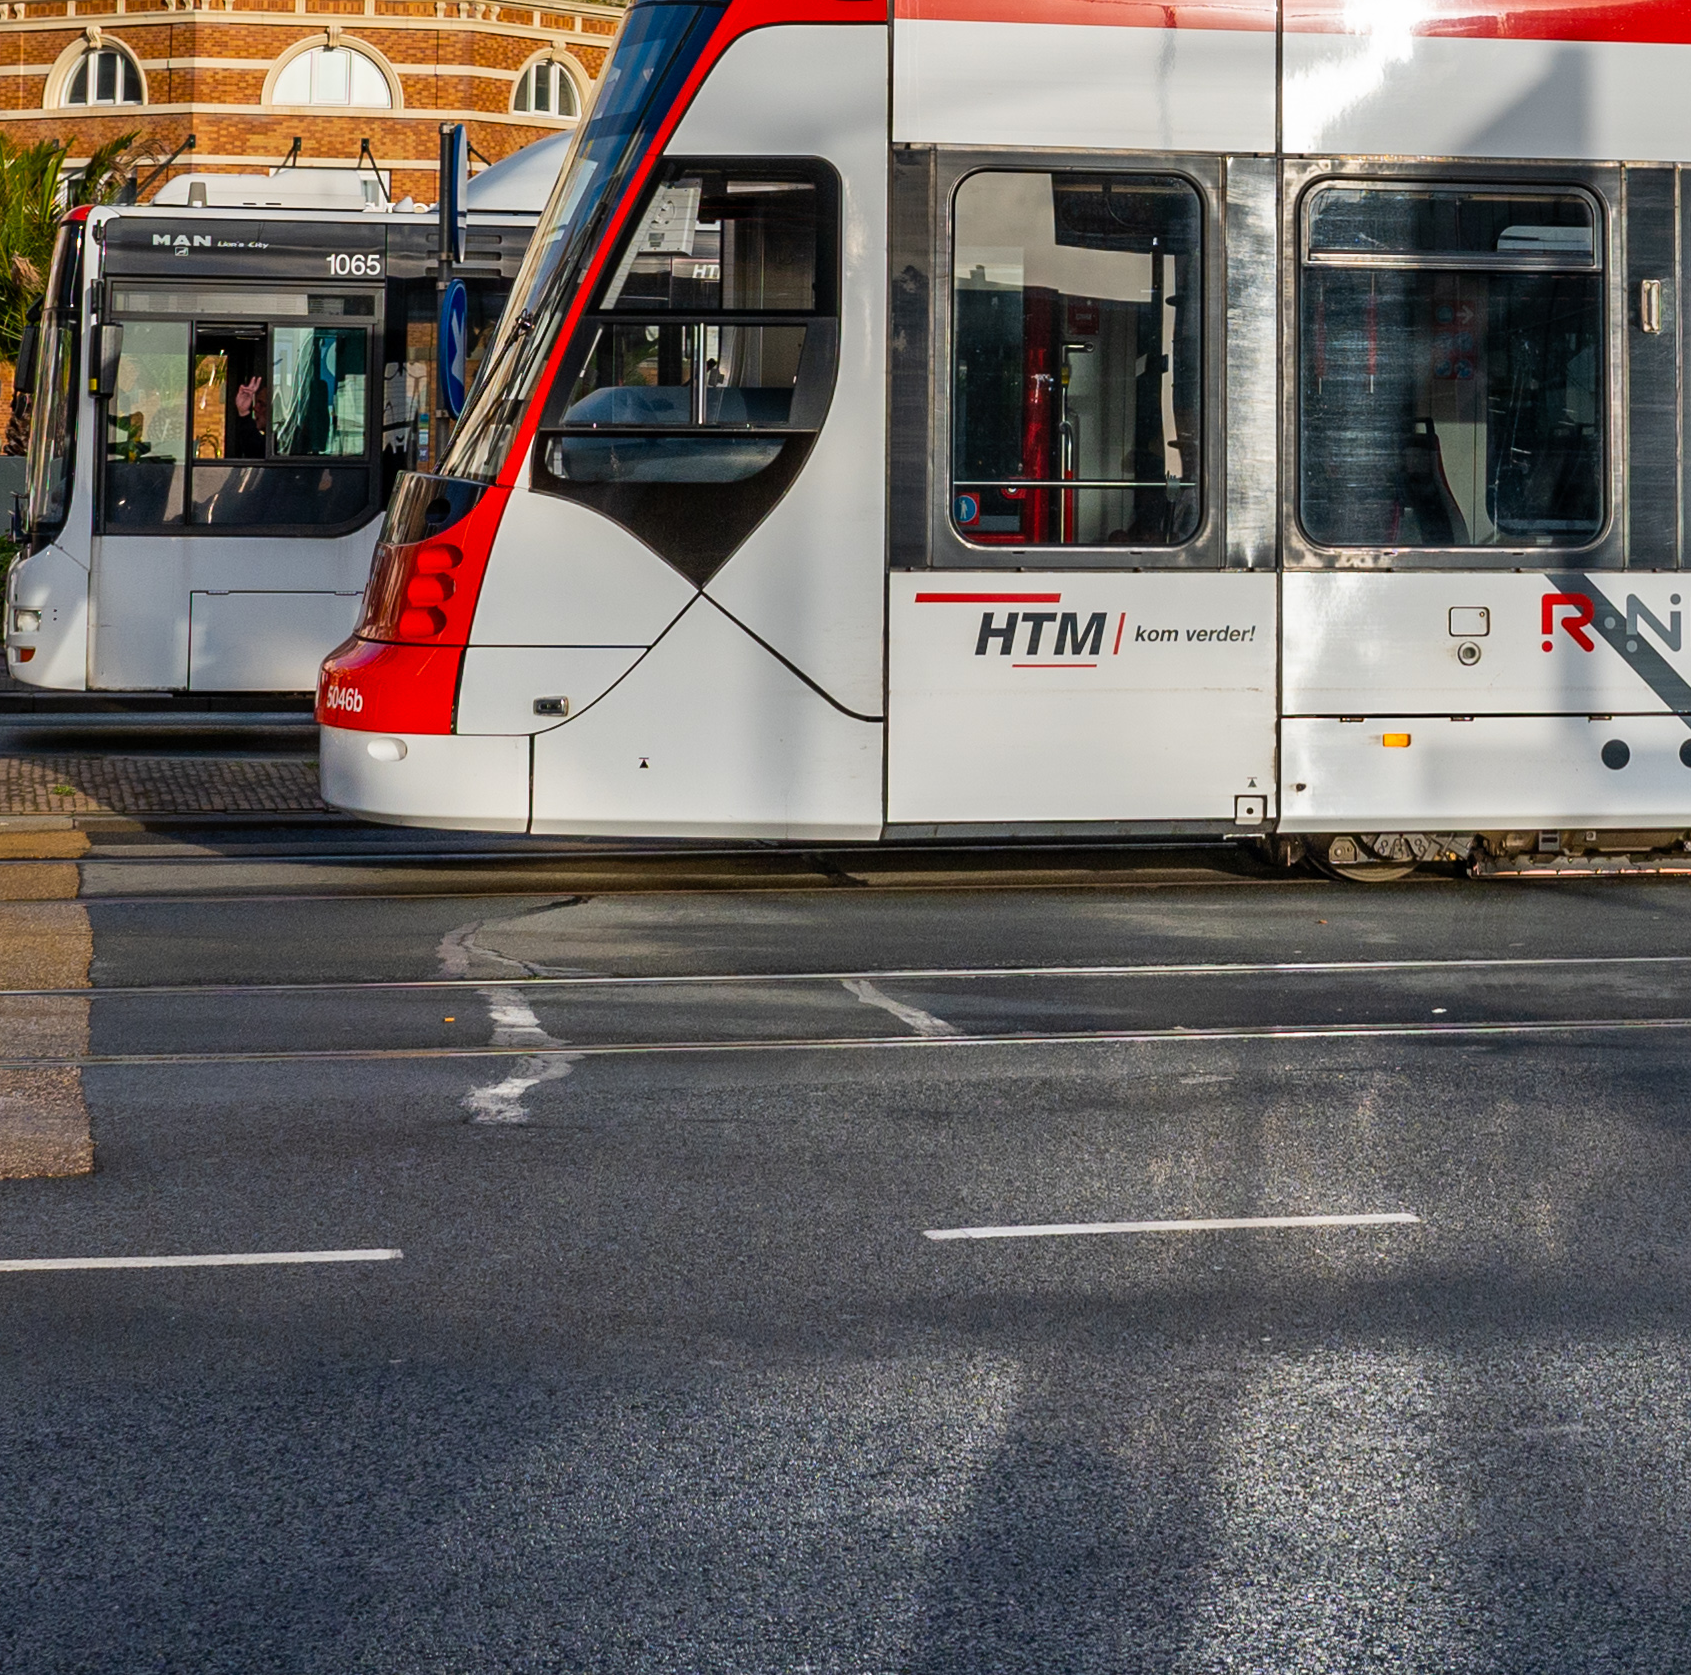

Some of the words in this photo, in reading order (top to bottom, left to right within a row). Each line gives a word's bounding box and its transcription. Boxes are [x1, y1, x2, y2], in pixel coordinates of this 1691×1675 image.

[152, 233, 212, 247] MAN
[216, 240, 245, 248] Lion's
[247, 240, 270, 250] City
[325, 253, 381, 276] 1065
[974, 611, 1108, 656] HTM
[1134, 625, 1179, 642] kom
[1185, 625, 1256, 642] verder!
[326, 684, 364, 713] 5046b
